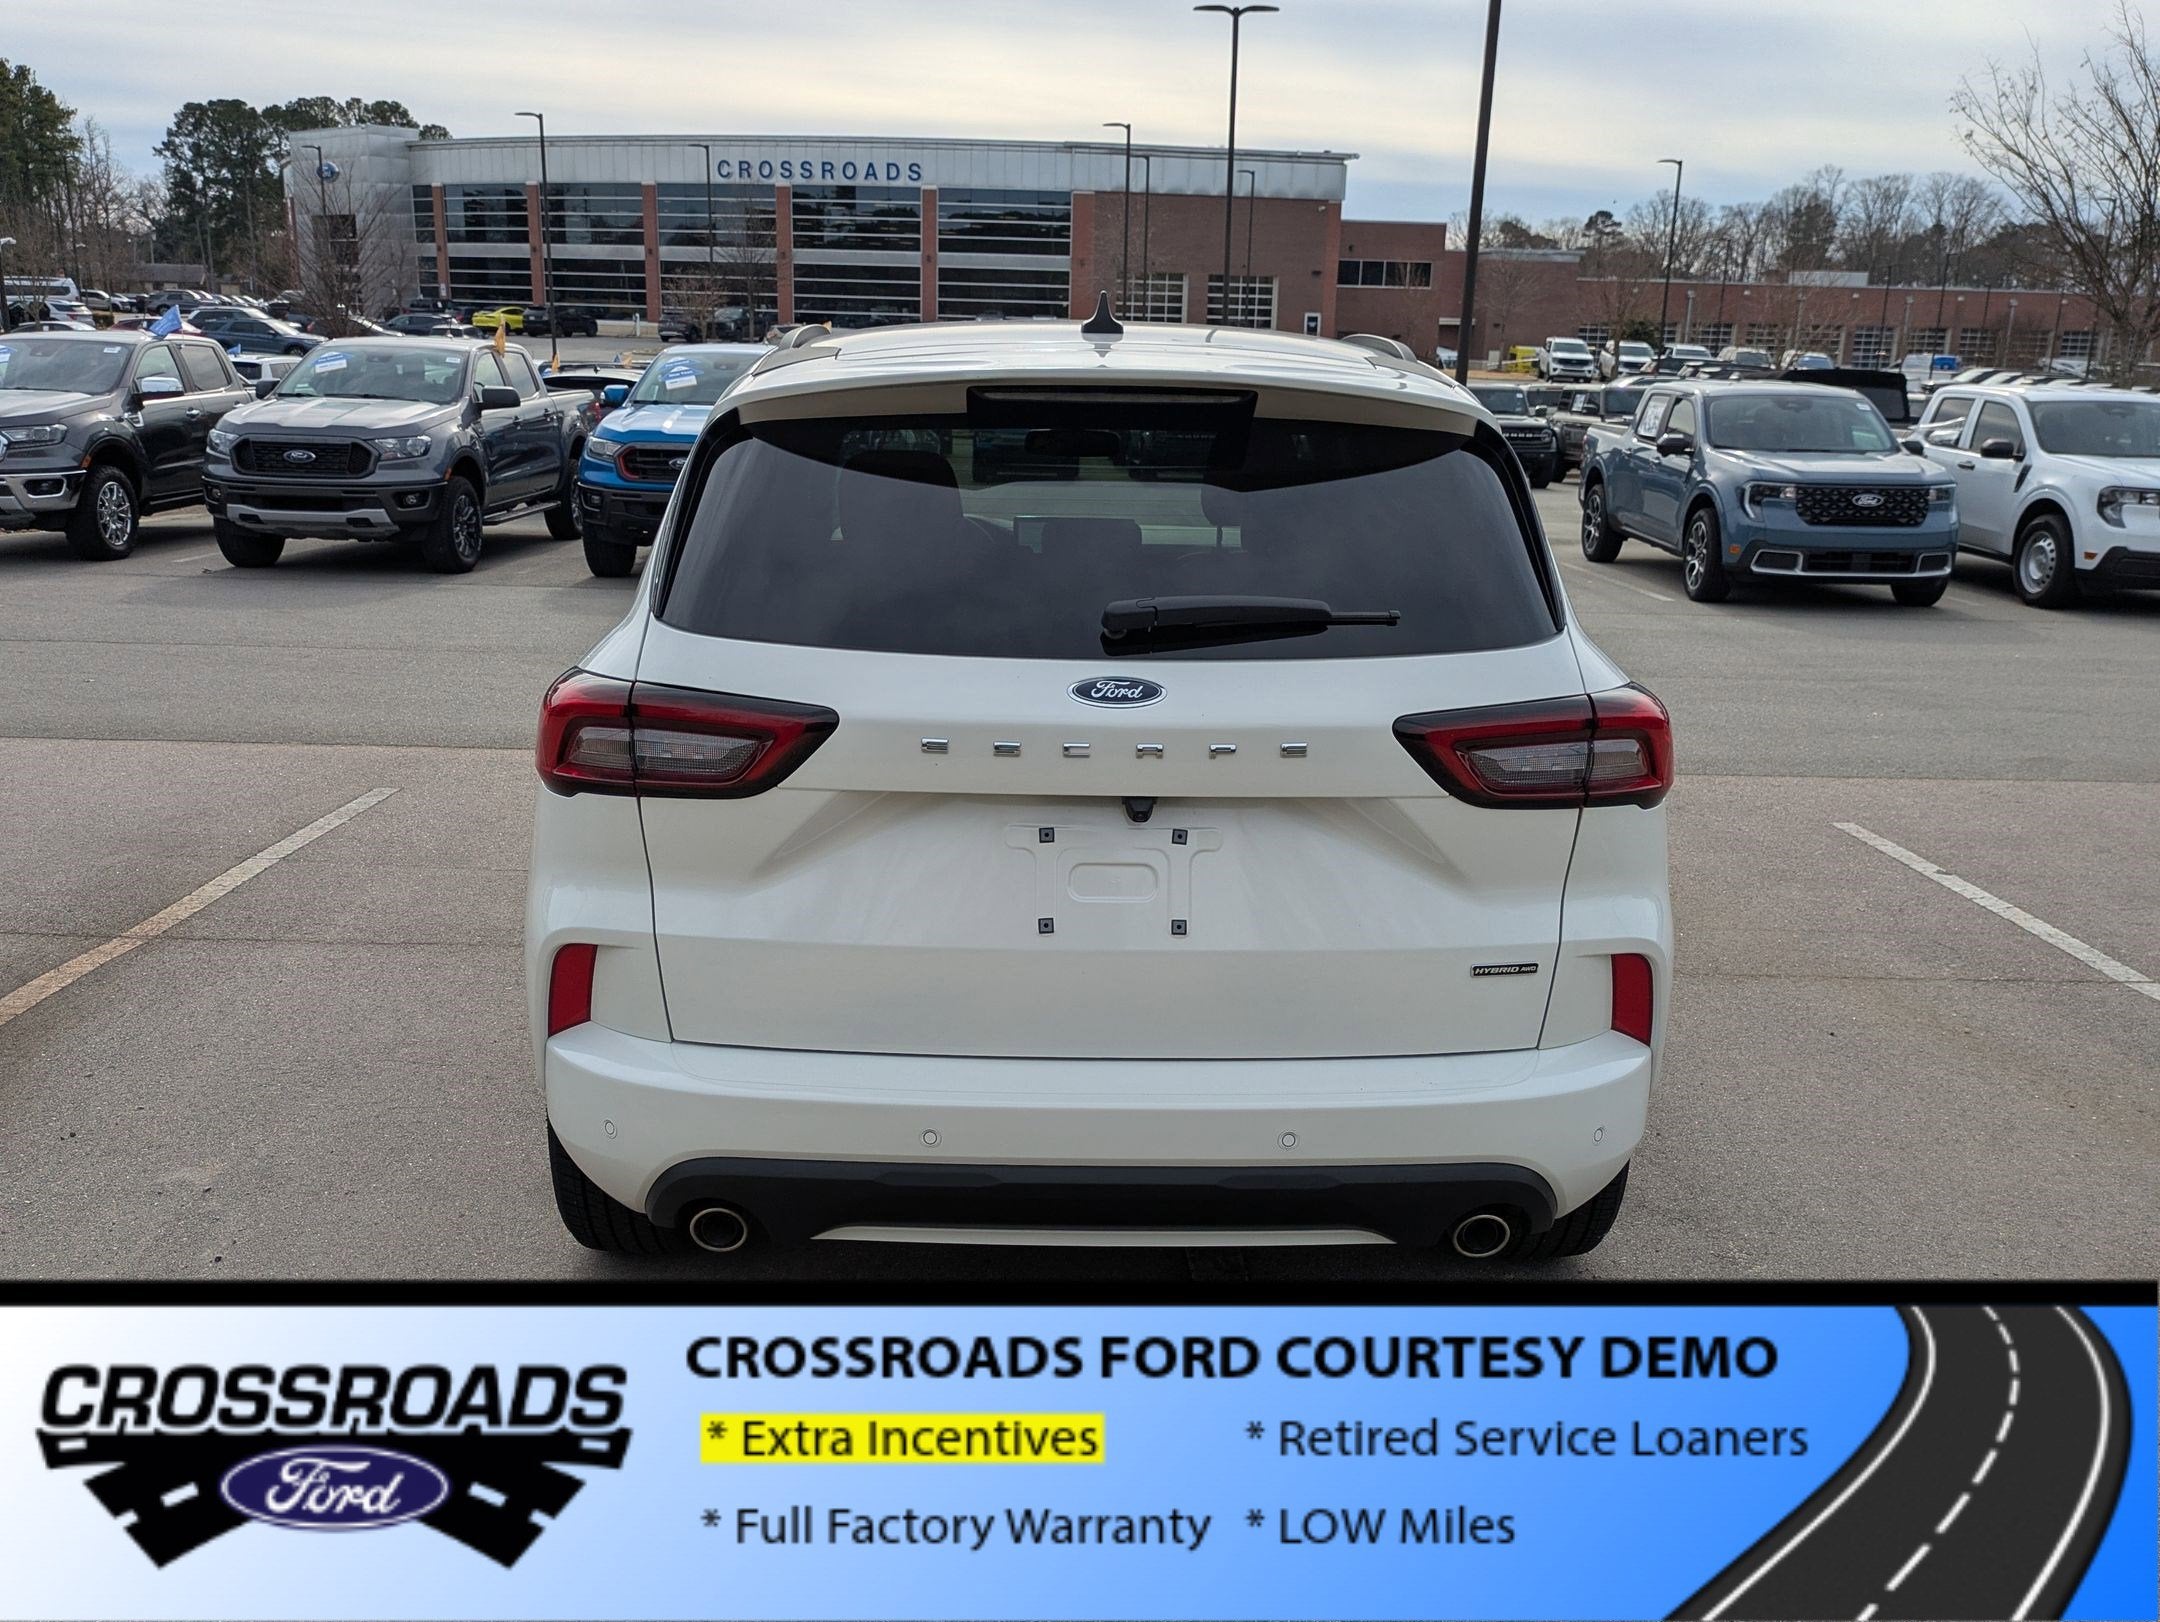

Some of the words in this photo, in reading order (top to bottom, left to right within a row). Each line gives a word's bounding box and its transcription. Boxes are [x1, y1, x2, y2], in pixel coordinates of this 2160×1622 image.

[717, 159, 923, 182] CROSSROADS
[1090, 680, 1144, 700] Ford
[920, 736, 1309, 759] ESCAPE
[1474, 966, 1520, 975] HYBRID
